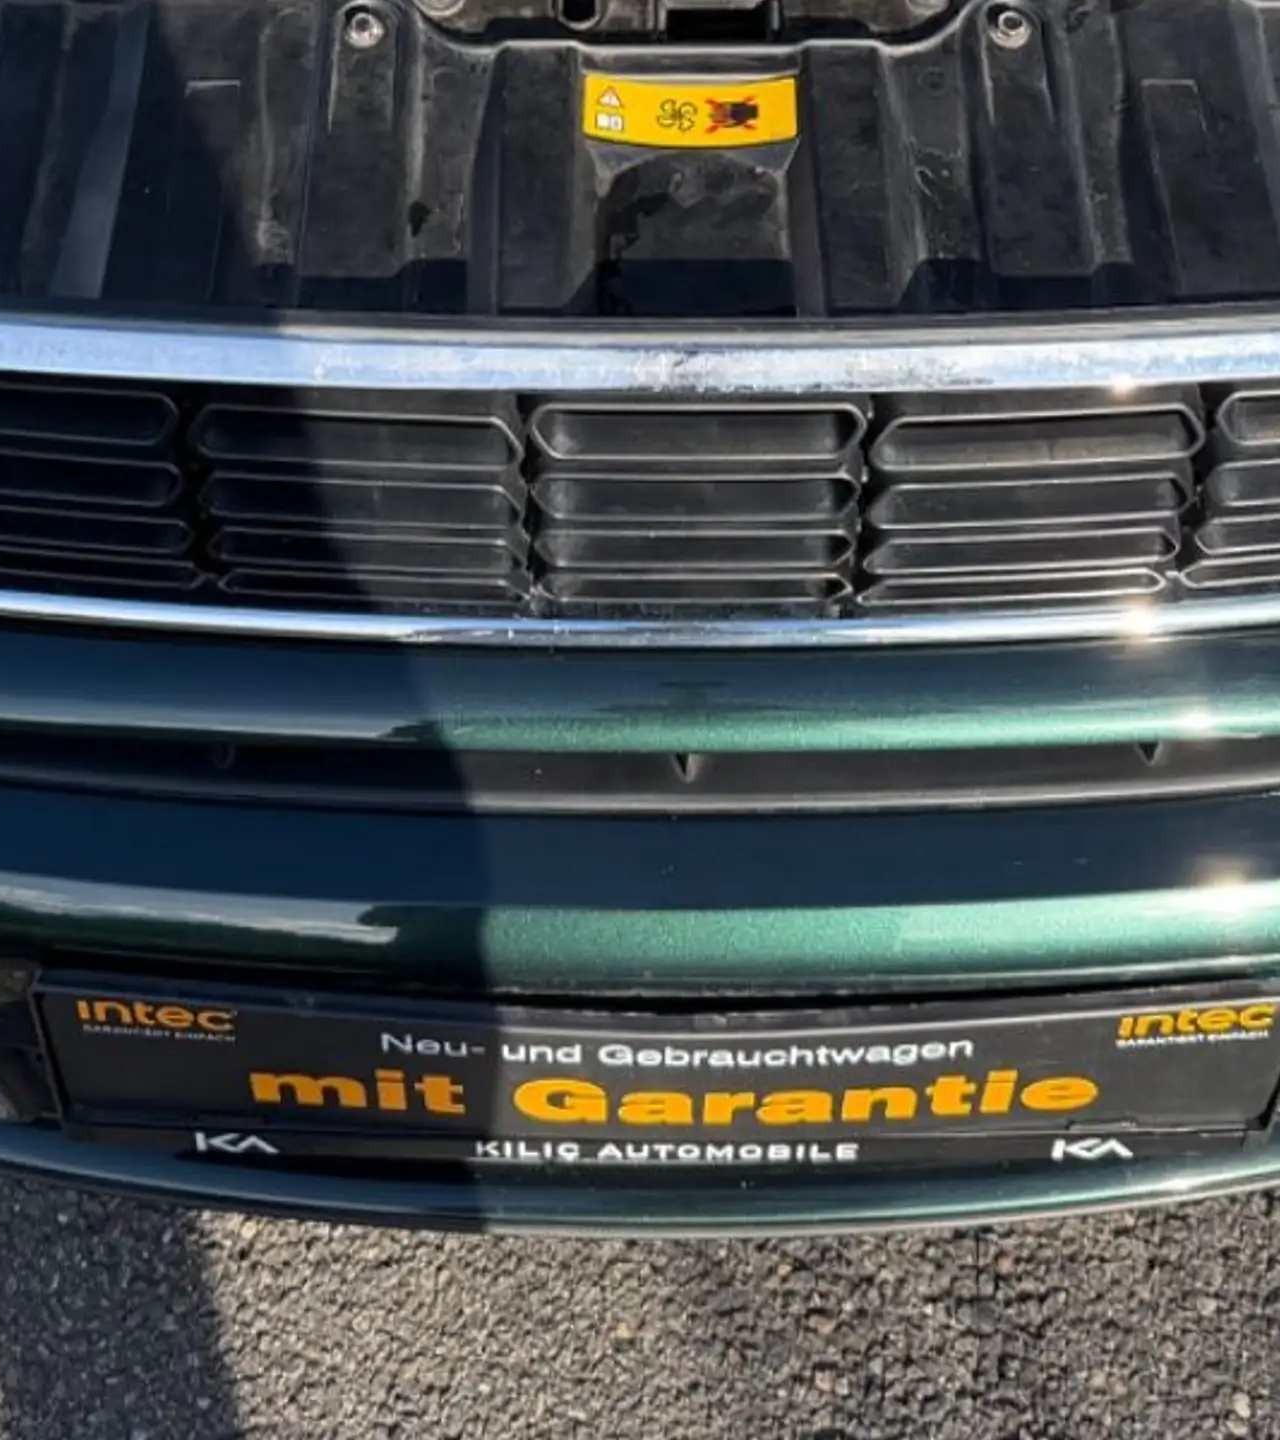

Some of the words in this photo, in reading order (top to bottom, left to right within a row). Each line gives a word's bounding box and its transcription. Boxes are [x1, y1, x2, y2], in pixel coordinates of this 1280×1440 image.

[380, 1032, 485, 1056] Neu-
[501, 1045, 581, 1064] und
[598, 1038, 973, 1067] Gebrauchtwagen
[249, 1068, 465, 1115] mit
[512, 1070, 1098, 1124] Garantie
[596, 1141, 860, 1161] AUTOMOBILE
